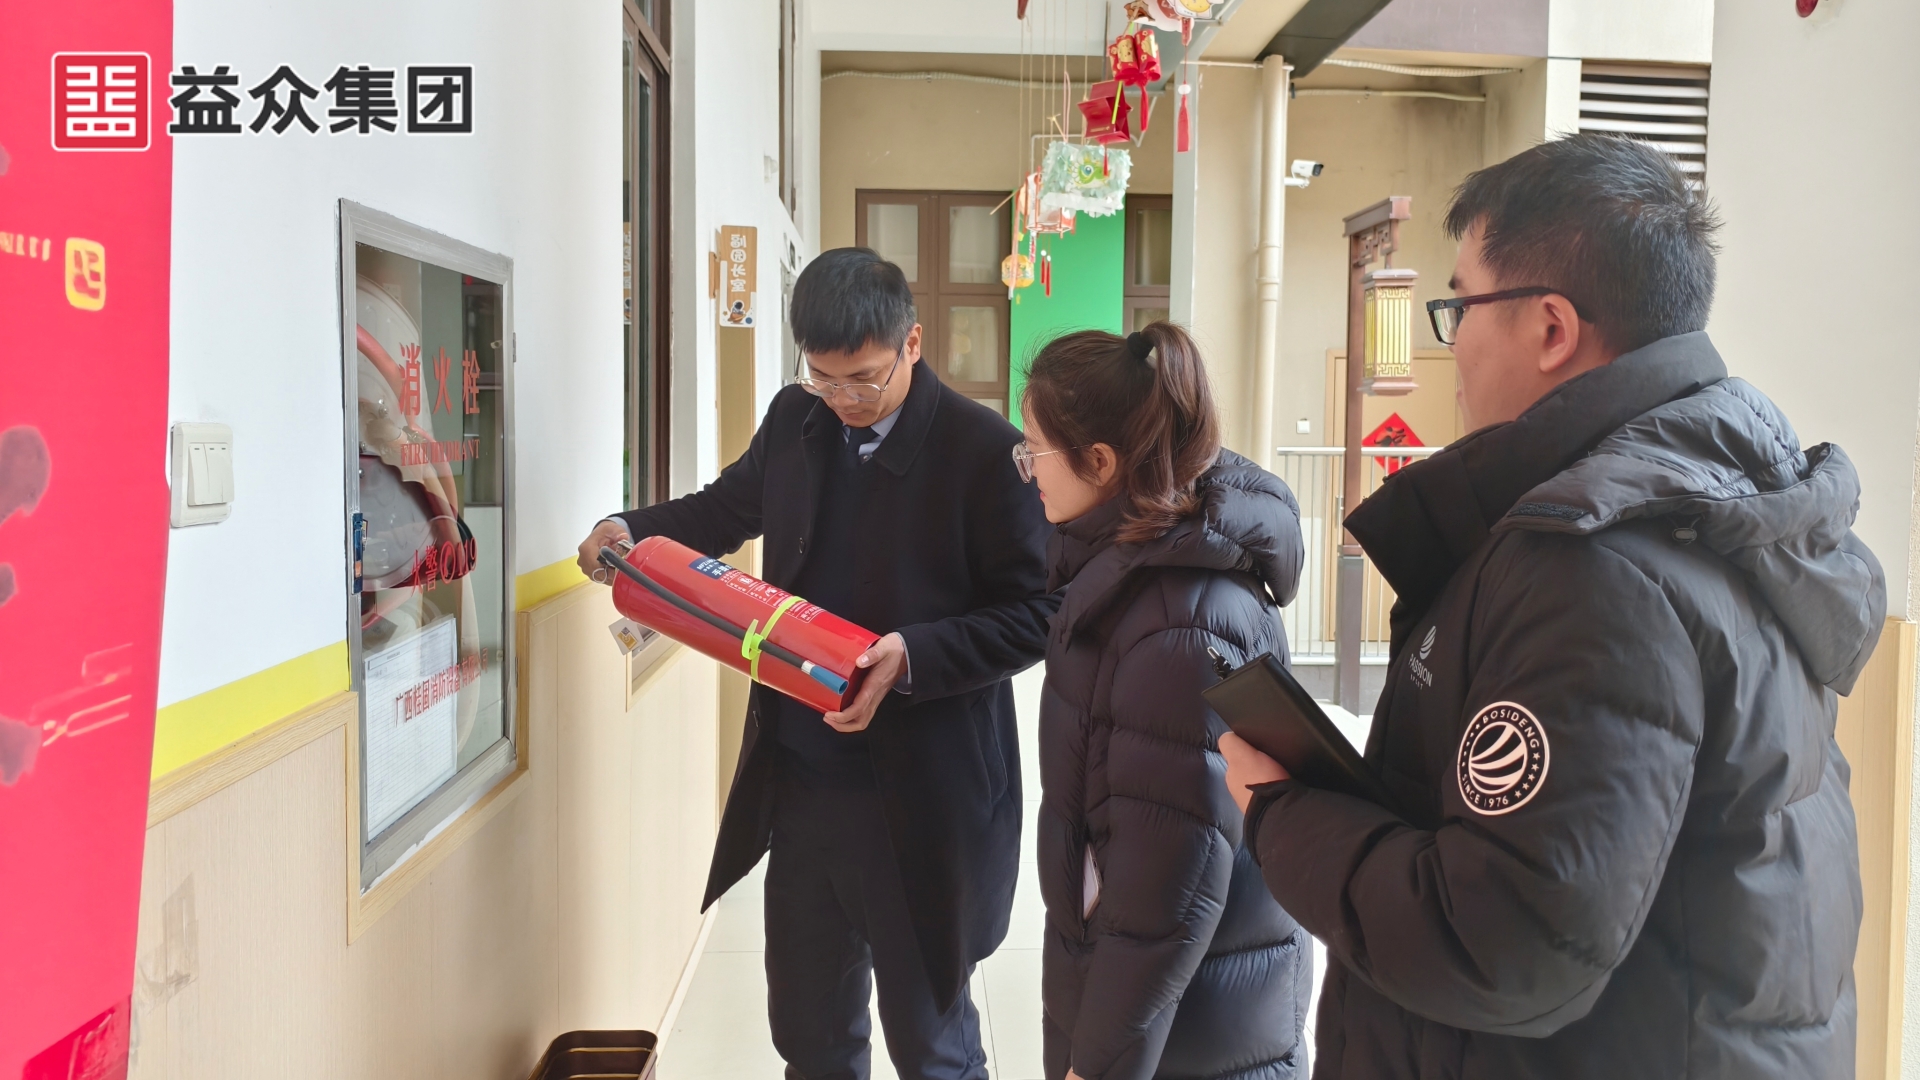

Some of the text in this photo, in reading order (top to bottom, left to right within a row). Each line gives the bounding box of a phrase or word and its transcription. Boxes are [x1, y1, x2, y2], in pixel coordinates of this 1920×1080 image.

[730, 234, 747, 292] 副园长室
[399, 342, 480, 416] 消火栓
[401, 439, 480, 466] FIRE HYDRANT
[411, 537, 478, 597] 火警 119
[1408, 653, 1433, 687] PASSION
[1481, 708, 1540, 748] BOSIDENG
[1461, 774, 1509, 808] SINCE 1976
